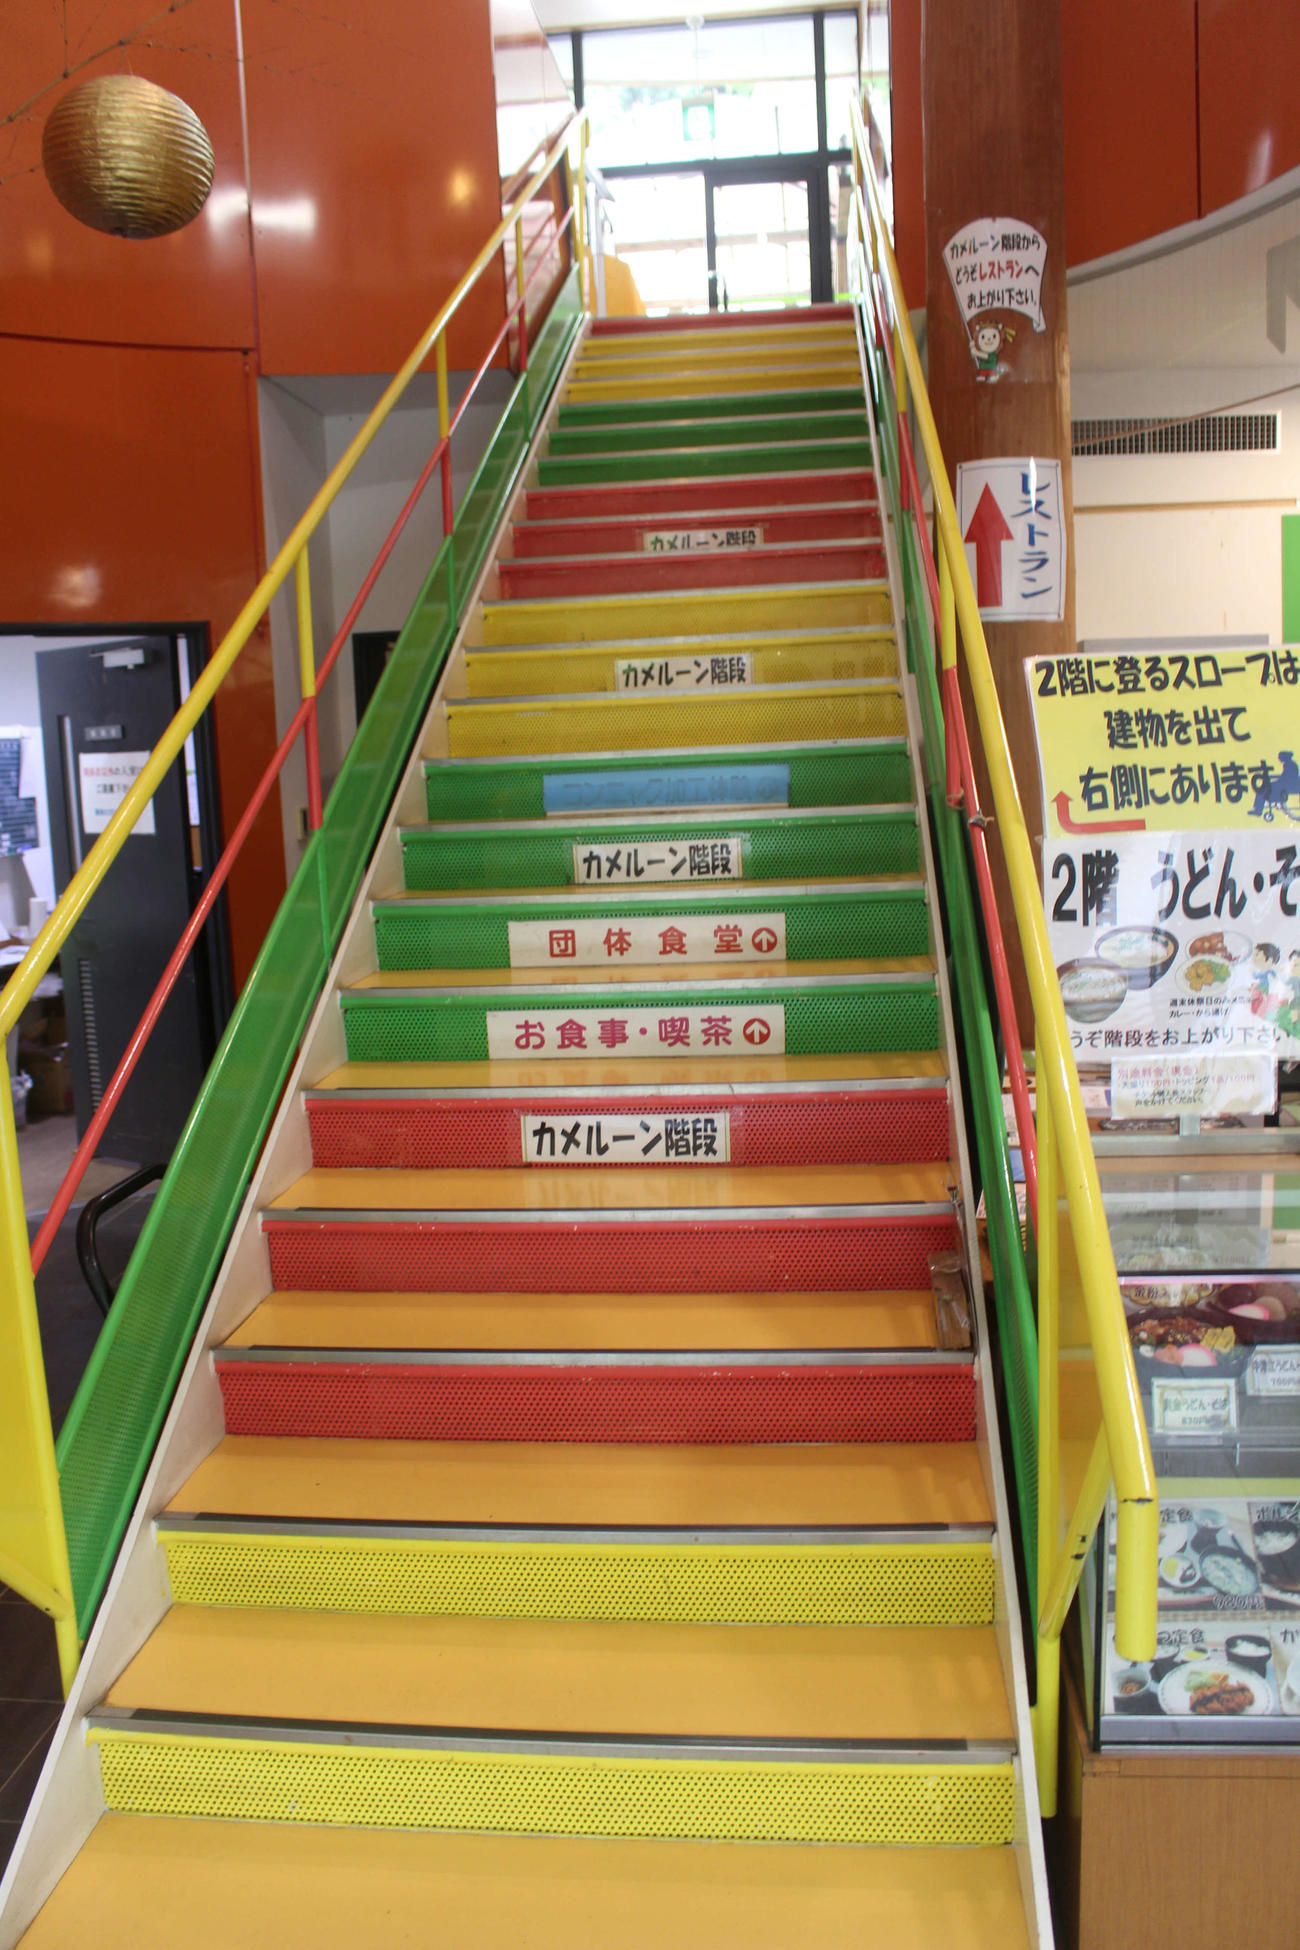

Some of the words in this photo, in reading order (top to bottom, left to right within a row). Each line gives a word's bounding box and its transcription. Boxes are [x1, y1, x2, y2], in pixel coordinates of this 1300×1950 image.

[949, 232, 1041, 260] カメルーン階段から
[955, 260, 1040, 286] どうぞレストランへ
[1010, 472, 1052, 599] レストラン
[622, 657, 746, 688] カメルーン階段
[1035, 650, 1300, 697] 2階に登るスロープは
[1104, 705, 1251, 749] 建物を出て
[1079, 760, 1275, 812] 右側にあります
[583, 844, 732, 879] カメルーン階段
[1051, 849, 1120, 927] 2階
[549, 924, 743, 958] 団体食堂
[515, 1015, 732, 1050] お食事・喫茶
[532, 1118, 718, 1157] カメルーン階段
